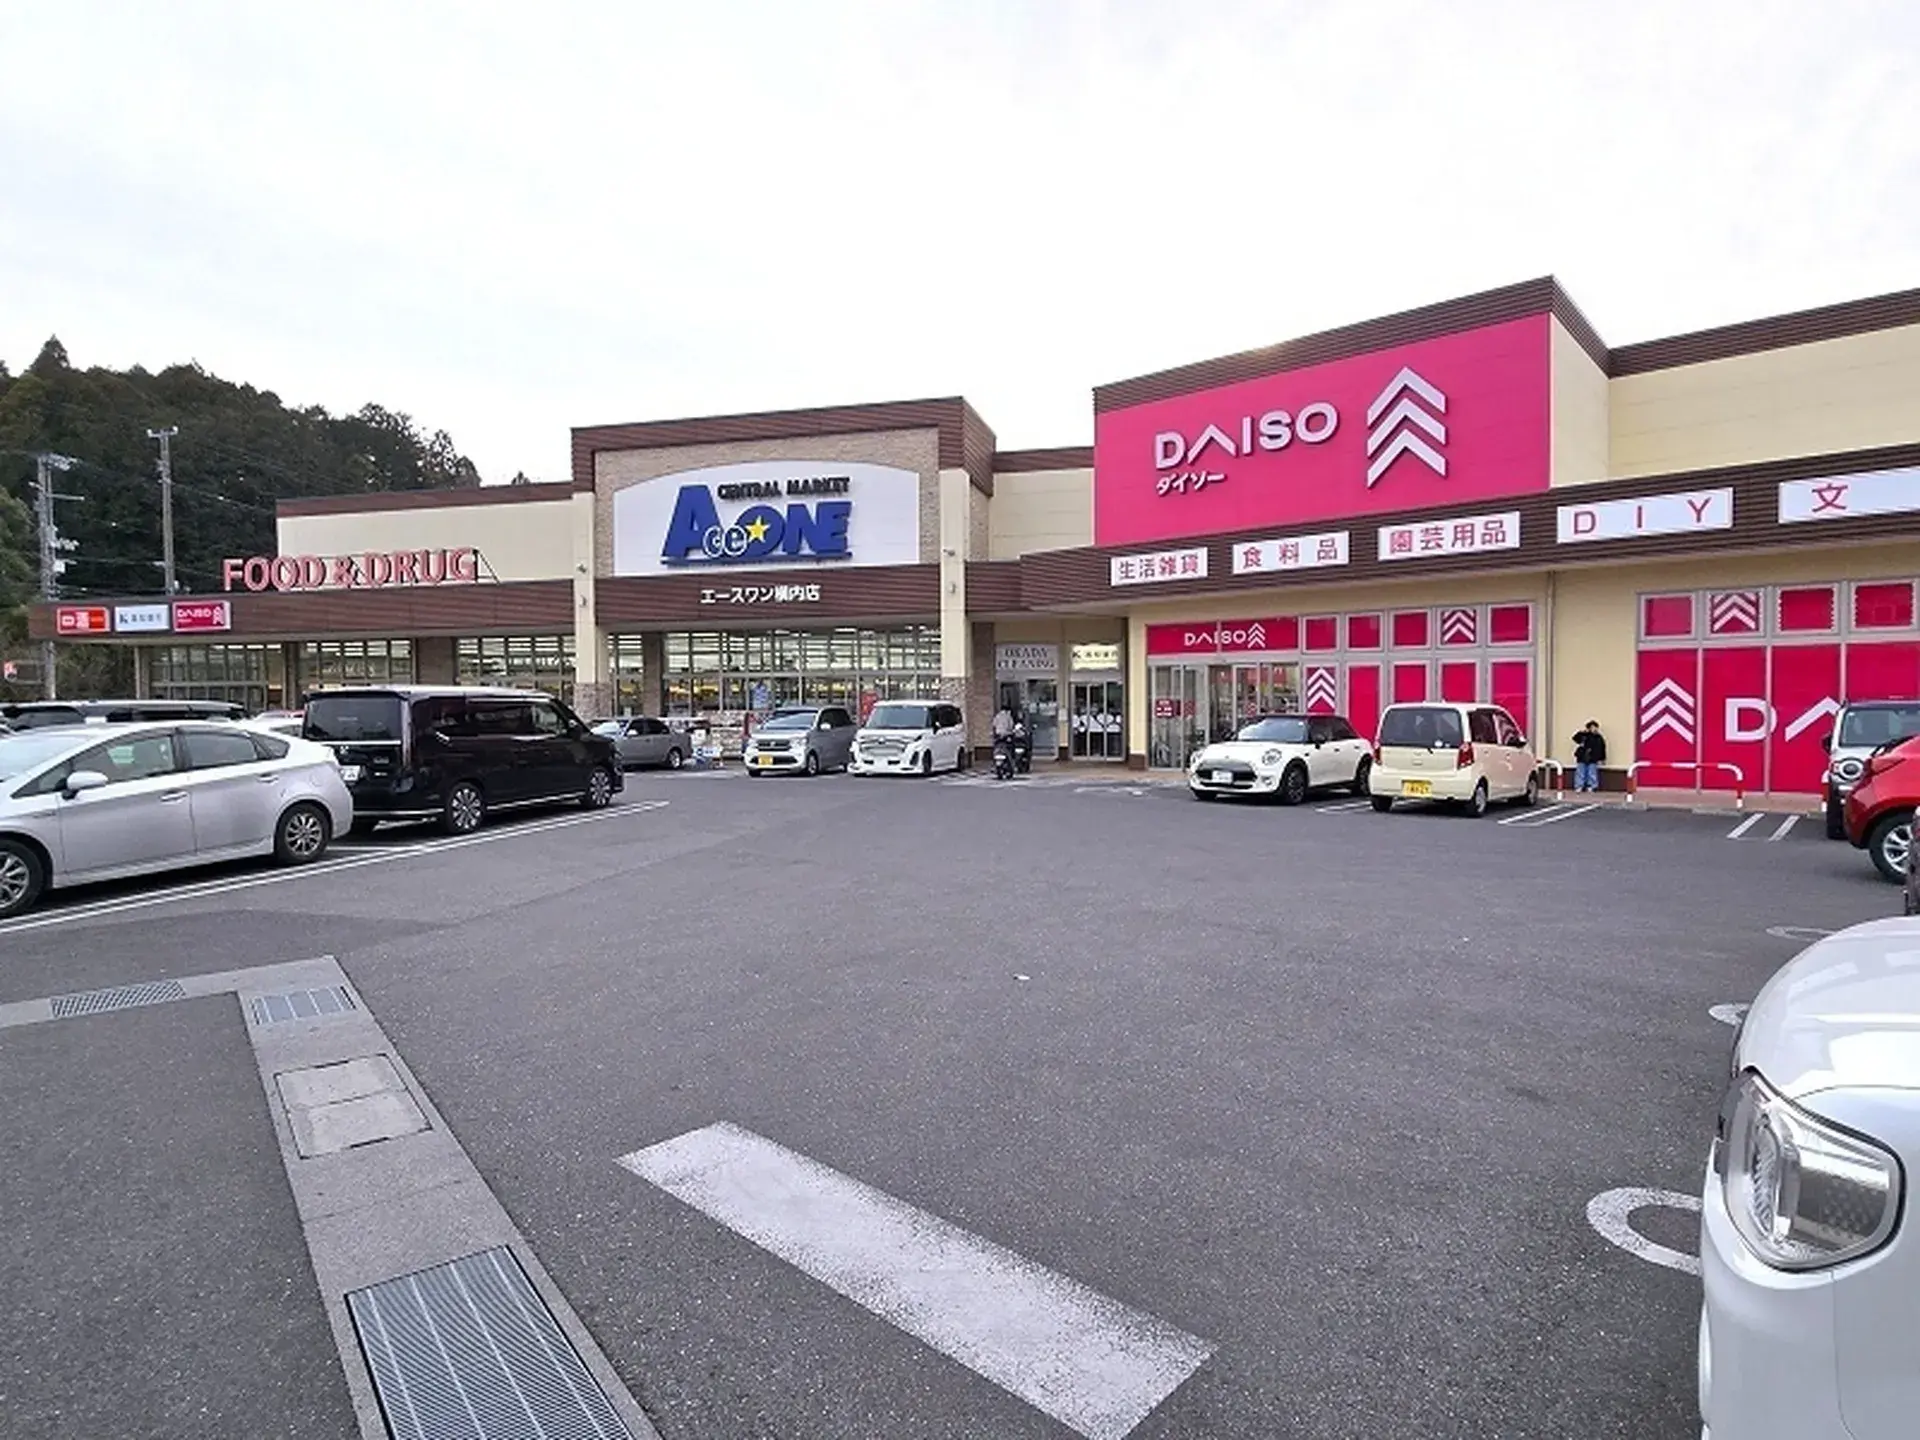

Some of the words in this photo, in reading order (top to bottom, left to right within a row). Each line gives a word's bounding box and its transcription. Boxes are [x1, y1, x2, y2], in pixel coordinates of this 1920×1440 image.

[1155, 402, 1338, 469] DAISO
[717, 481, 782, 500] CENTRAL
[786, 477, 851, 496] MARKET
[1156, 470, 1226, 496] ダイソー
[1389, 519, 1507, 554] 園芸用品
[1242, 538, 1339, 568] 食料品
[223, 555, 326, 593] FOOD
[364, 547, 476, 588] DRUG
[1118, 554, 1200, 581] 生活雑貨
[1183, 629, 1247, 646] DAISO
